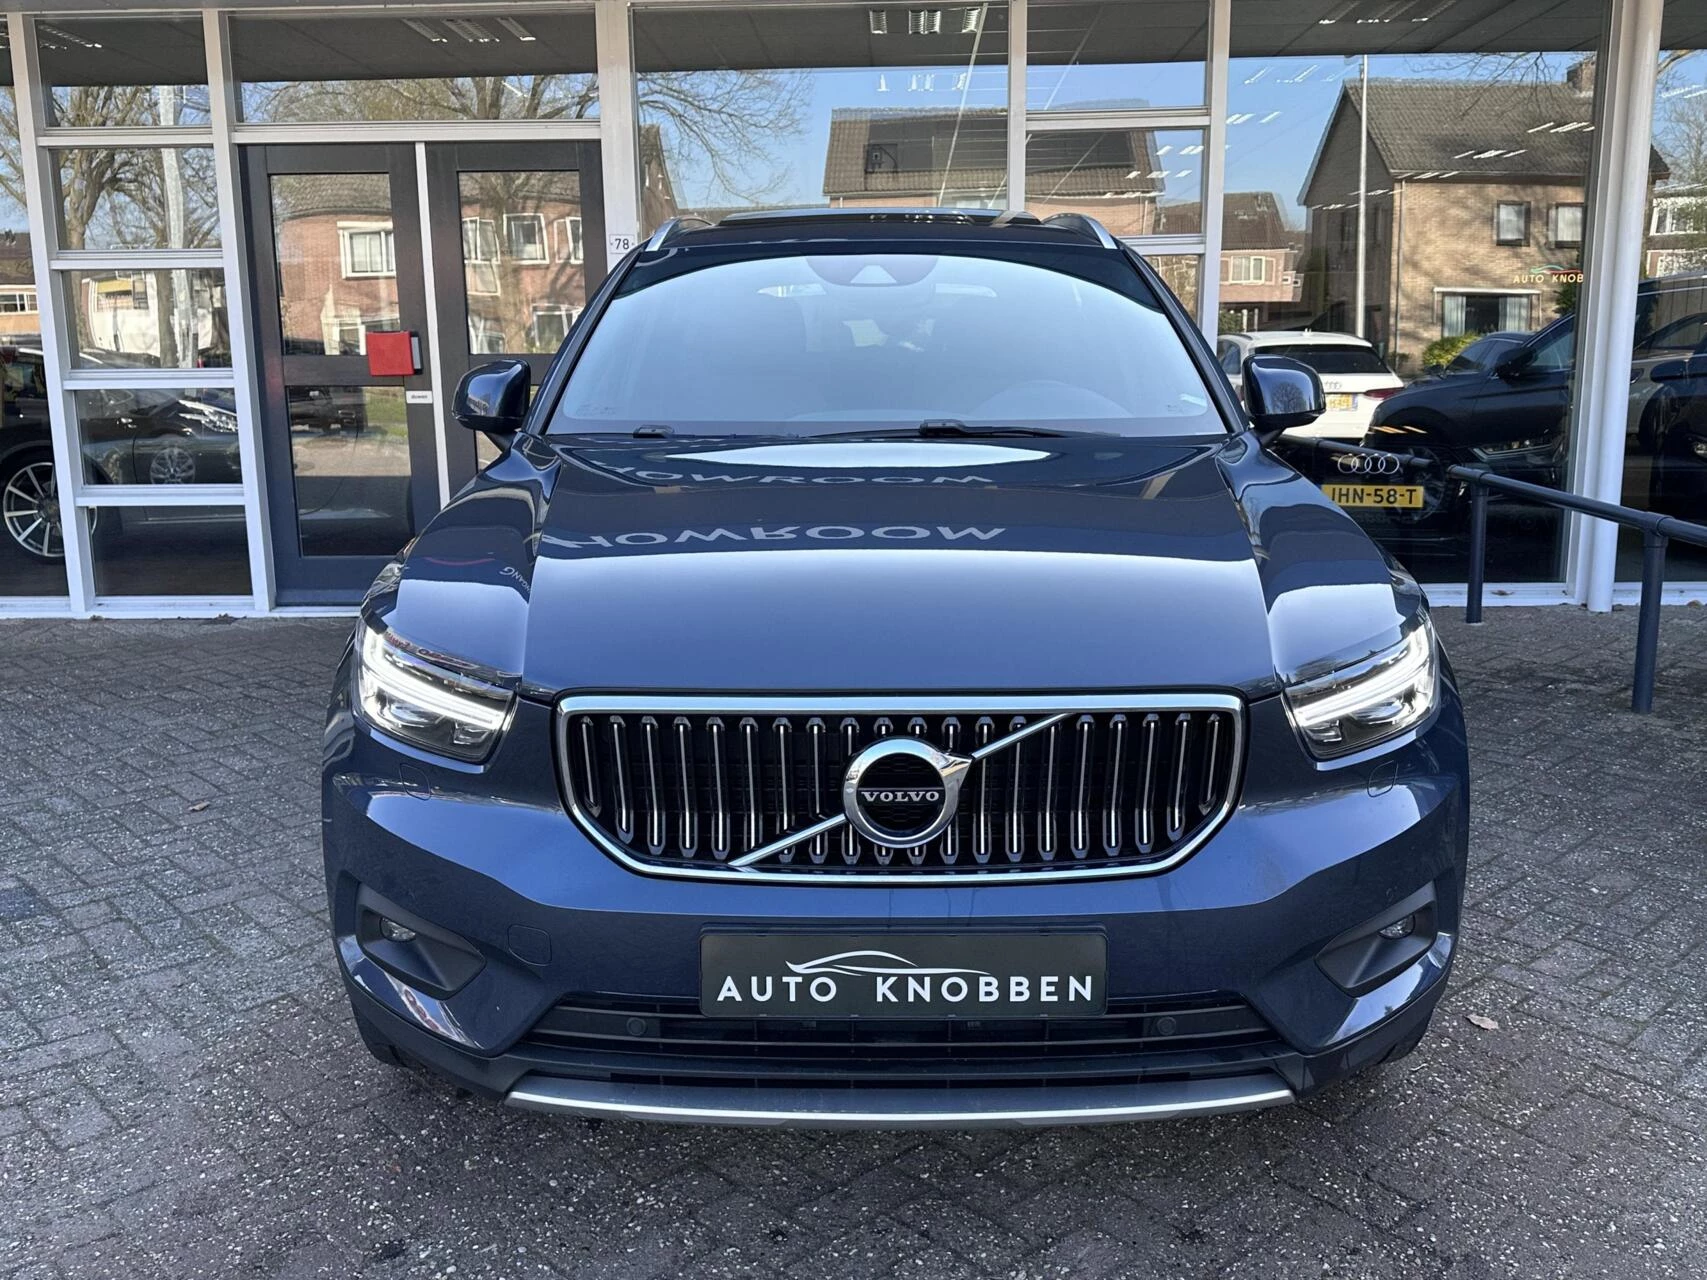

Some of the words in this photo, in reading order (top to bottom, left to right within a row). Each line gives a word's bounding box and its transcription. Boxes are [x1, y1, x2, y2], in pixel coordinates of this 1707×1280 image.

[614, 237, 630, 250] 78
[1512, 274, 1545, 284] AUTO
[1551, 273, 1584, 283] KNOB
[861, 791, 940, 802] VOLVO
[716, 975, 838, 1003] AUTO
[876, 975, 1093, 1003] KNOBBEN
